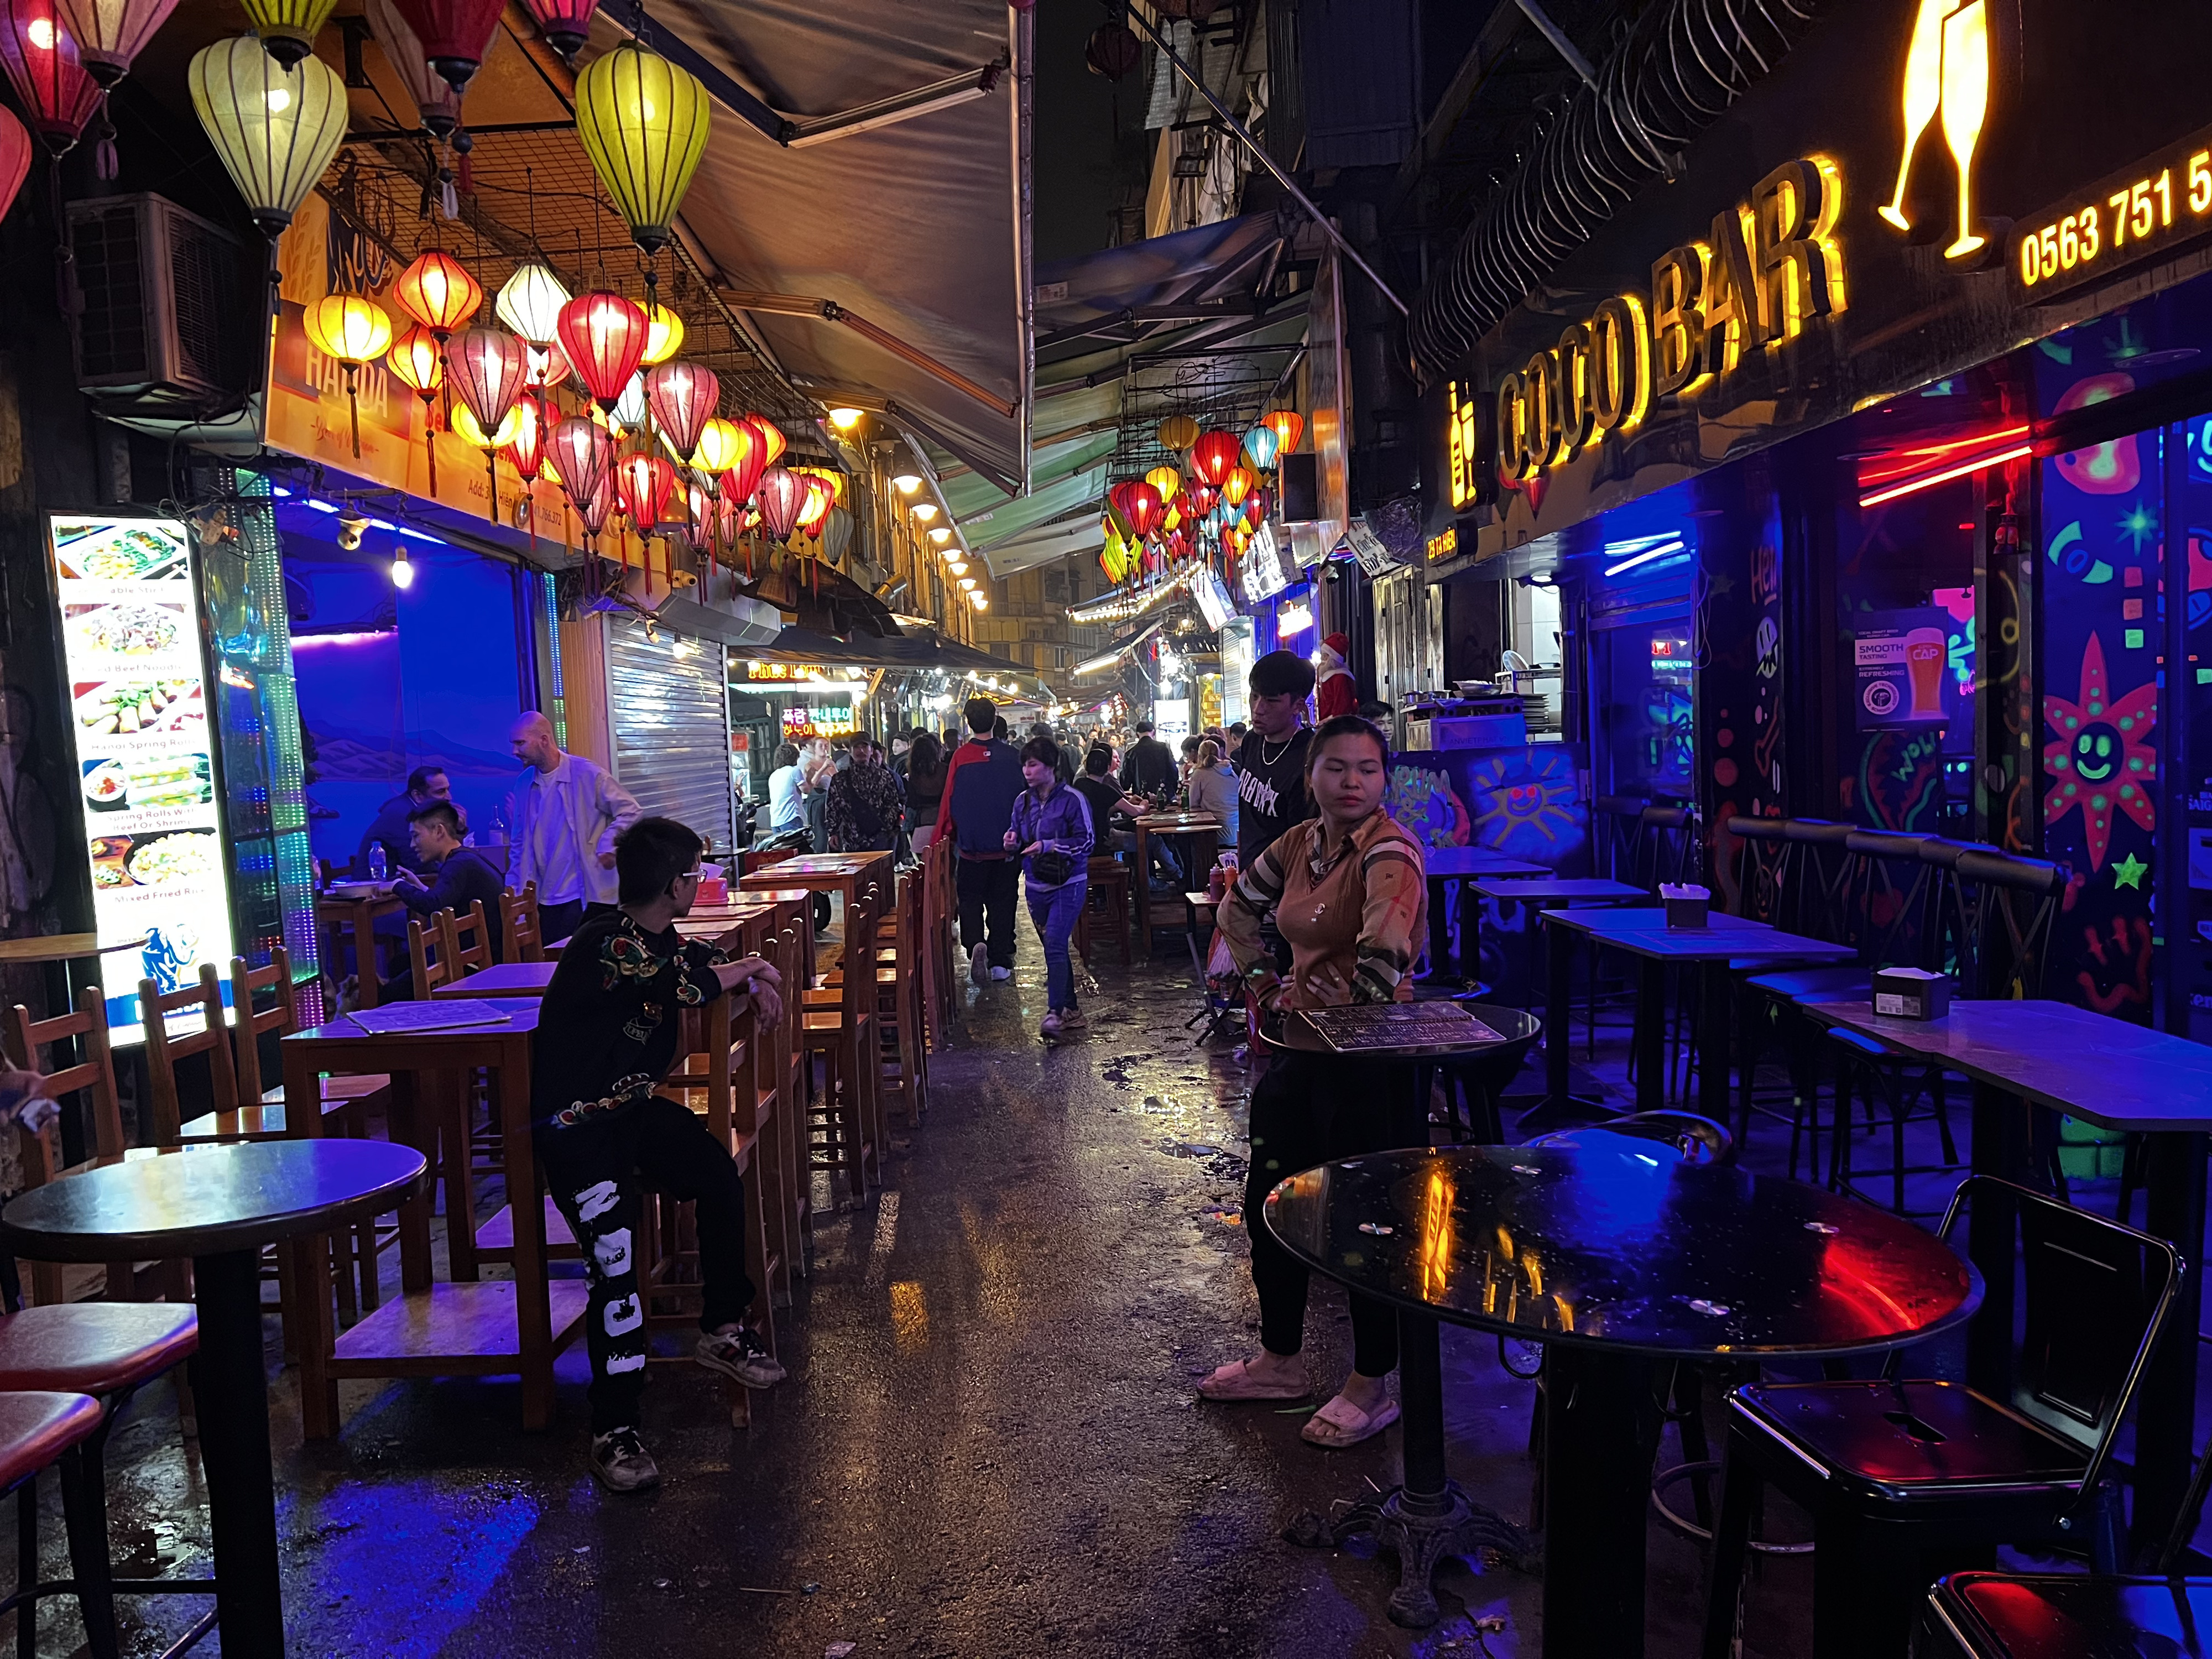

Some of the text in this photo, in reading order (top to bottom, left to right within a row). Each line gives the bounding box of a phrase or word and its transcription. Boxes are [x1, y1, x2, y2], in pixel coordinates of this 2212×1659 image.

[2022, 206, 2099, 285] 0563
[2109, 168, 2172, 247] 751
[1498, 154, 1848, 480] COCO BAR
[468, 479, 484, 499] Add:
[1859, 644, 1903, 653] SMOOTH
[1913, 649, 1938, 660] CAP
[129, 741, 166, 749] Spring
[146, 808, 171, 817] Rolls
[156, 818, 194, 828] Shrim
[115, 893, 149, 902] Mixed
[153, 889, 181, 899] Fried
